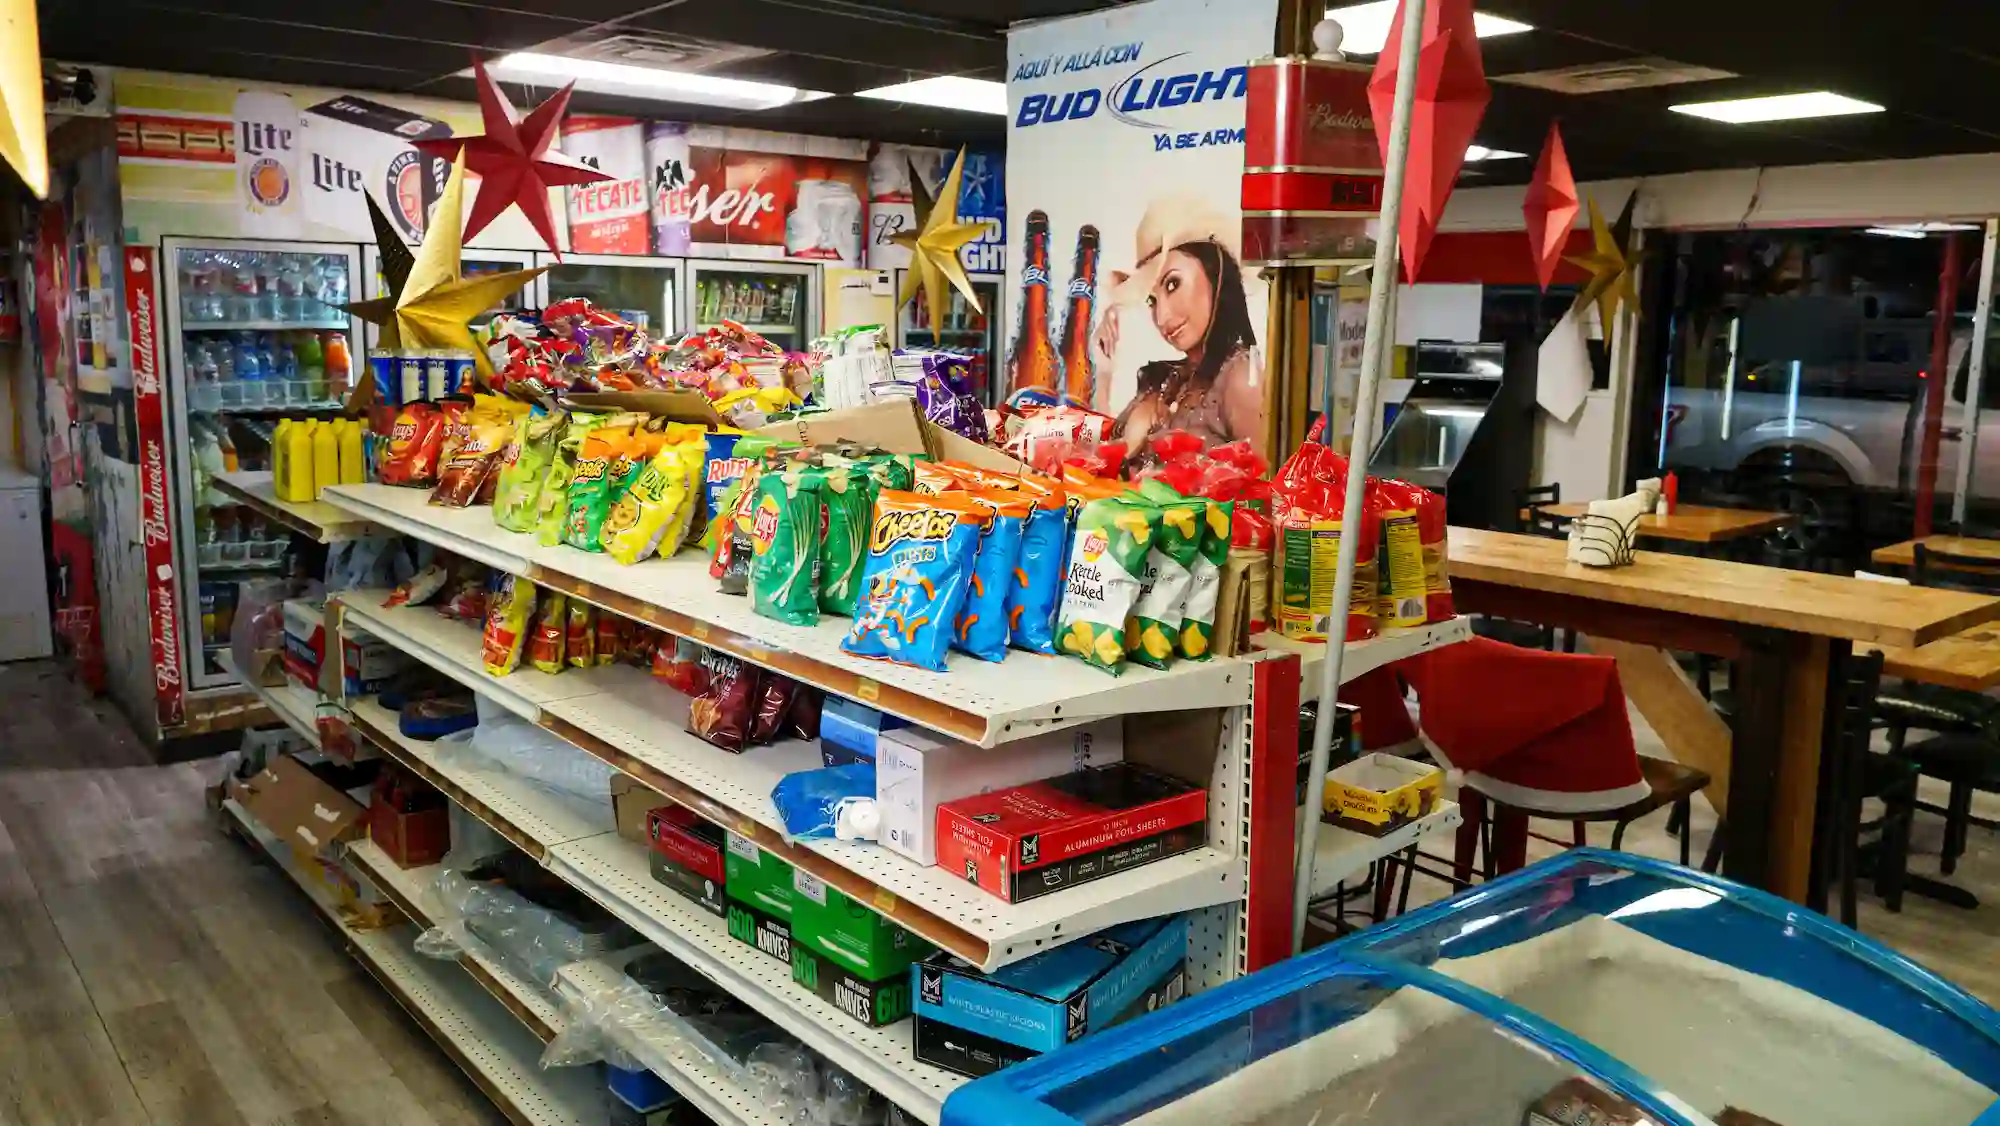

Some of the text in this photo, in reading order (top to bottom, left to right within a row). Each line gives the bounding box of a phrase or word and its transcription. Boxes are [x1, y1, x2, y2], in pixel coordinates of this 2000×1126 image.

[1053, 56, 1062, 75] Y
[1103, 41, 1143, 66] CON
[1016, 88, 1101, 128] BUD
[241, 121, 292, 156] Lite
[1153, 133, 1172, 151] YA
[1175, 132, 1199, 149] SE
[313, 152, 361, 193] Lite
[573, 180, 642, 218] TECATE
[134, 287, 160, 398] Budweiser
[144, 440, 169, 547] Budweiser
[873, 508, 957, 556] Cheetos
[1071, 562, 1102, 583] Kettle
[153, 586, 179, 690] Budweiser
[951, 820, 977, 839] SHEETS
[1064, 817, 1166, 852] ALUMINUM FOIL SHEETS
[728, 905, 755, 946] 600
[757, 926, 789, 961] KNIVES
[792, 947, 817, 989] 600
[835, 982, 870, 1023] KNIVES
[949, 995, 973, 1010] WHITE
